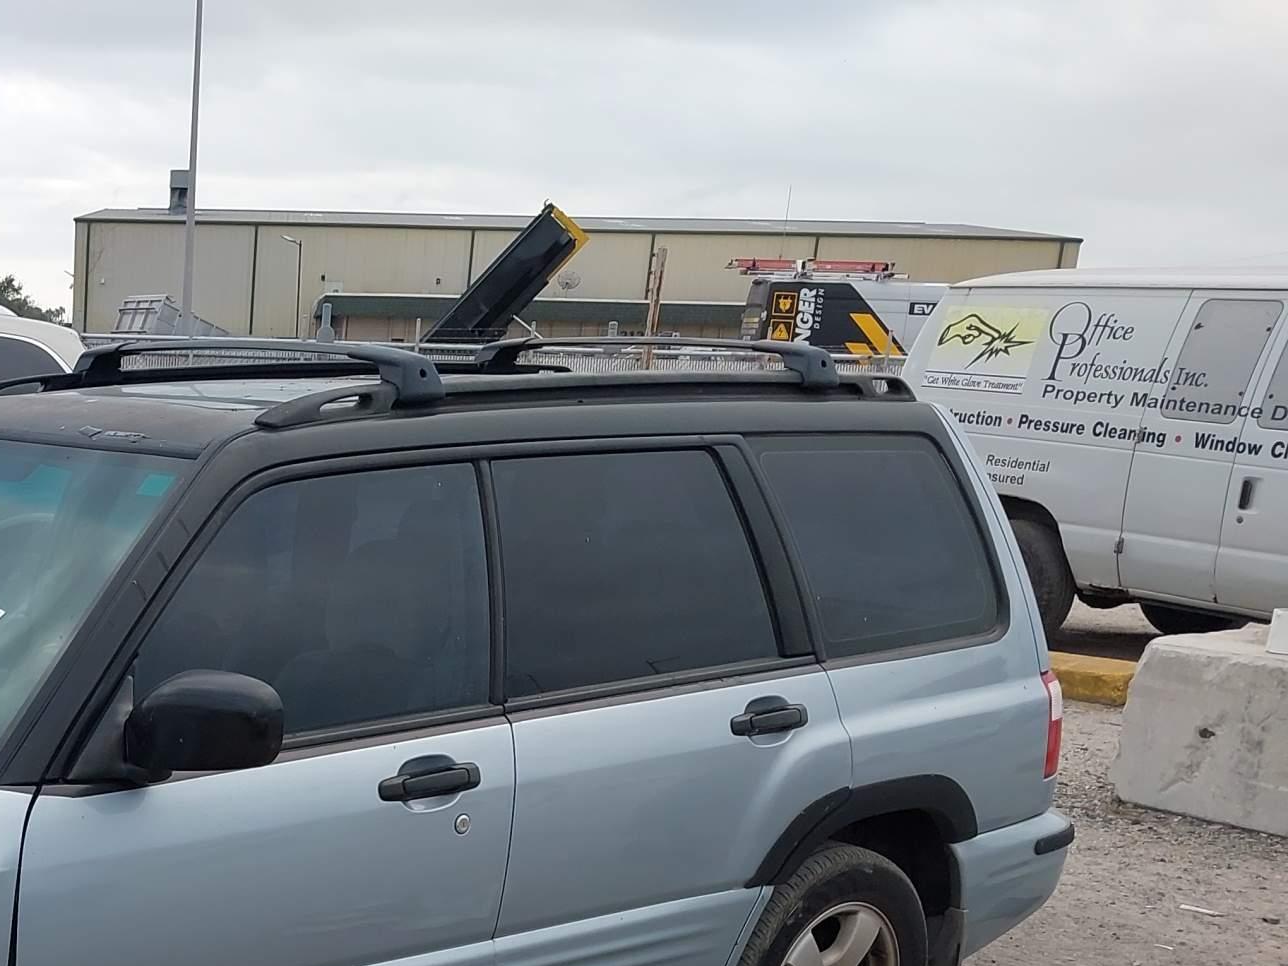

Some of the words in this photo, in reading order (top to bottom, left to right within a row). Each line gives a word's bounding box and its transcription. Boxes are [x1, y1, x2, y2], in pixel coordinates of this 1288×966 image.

[813, 288, 825, 330] DESIGN
[1049, 301, 1135, 346] Office
[1041, 332, 1171, 385] Professionals
[1173, 366, 1209, 388] Inc.
[1041, 384, 1124, 407] Property
[1130, 391, 1263, 419] Maintenance
[950, 408, 1003, 427] ruction
[1017, 414, 1085, 436] Pressure
[1092, 421, 1167, 447] Cleaning
[1194, 432, 1263, 456] Window
[985, 454, 1050, 473] Residential
